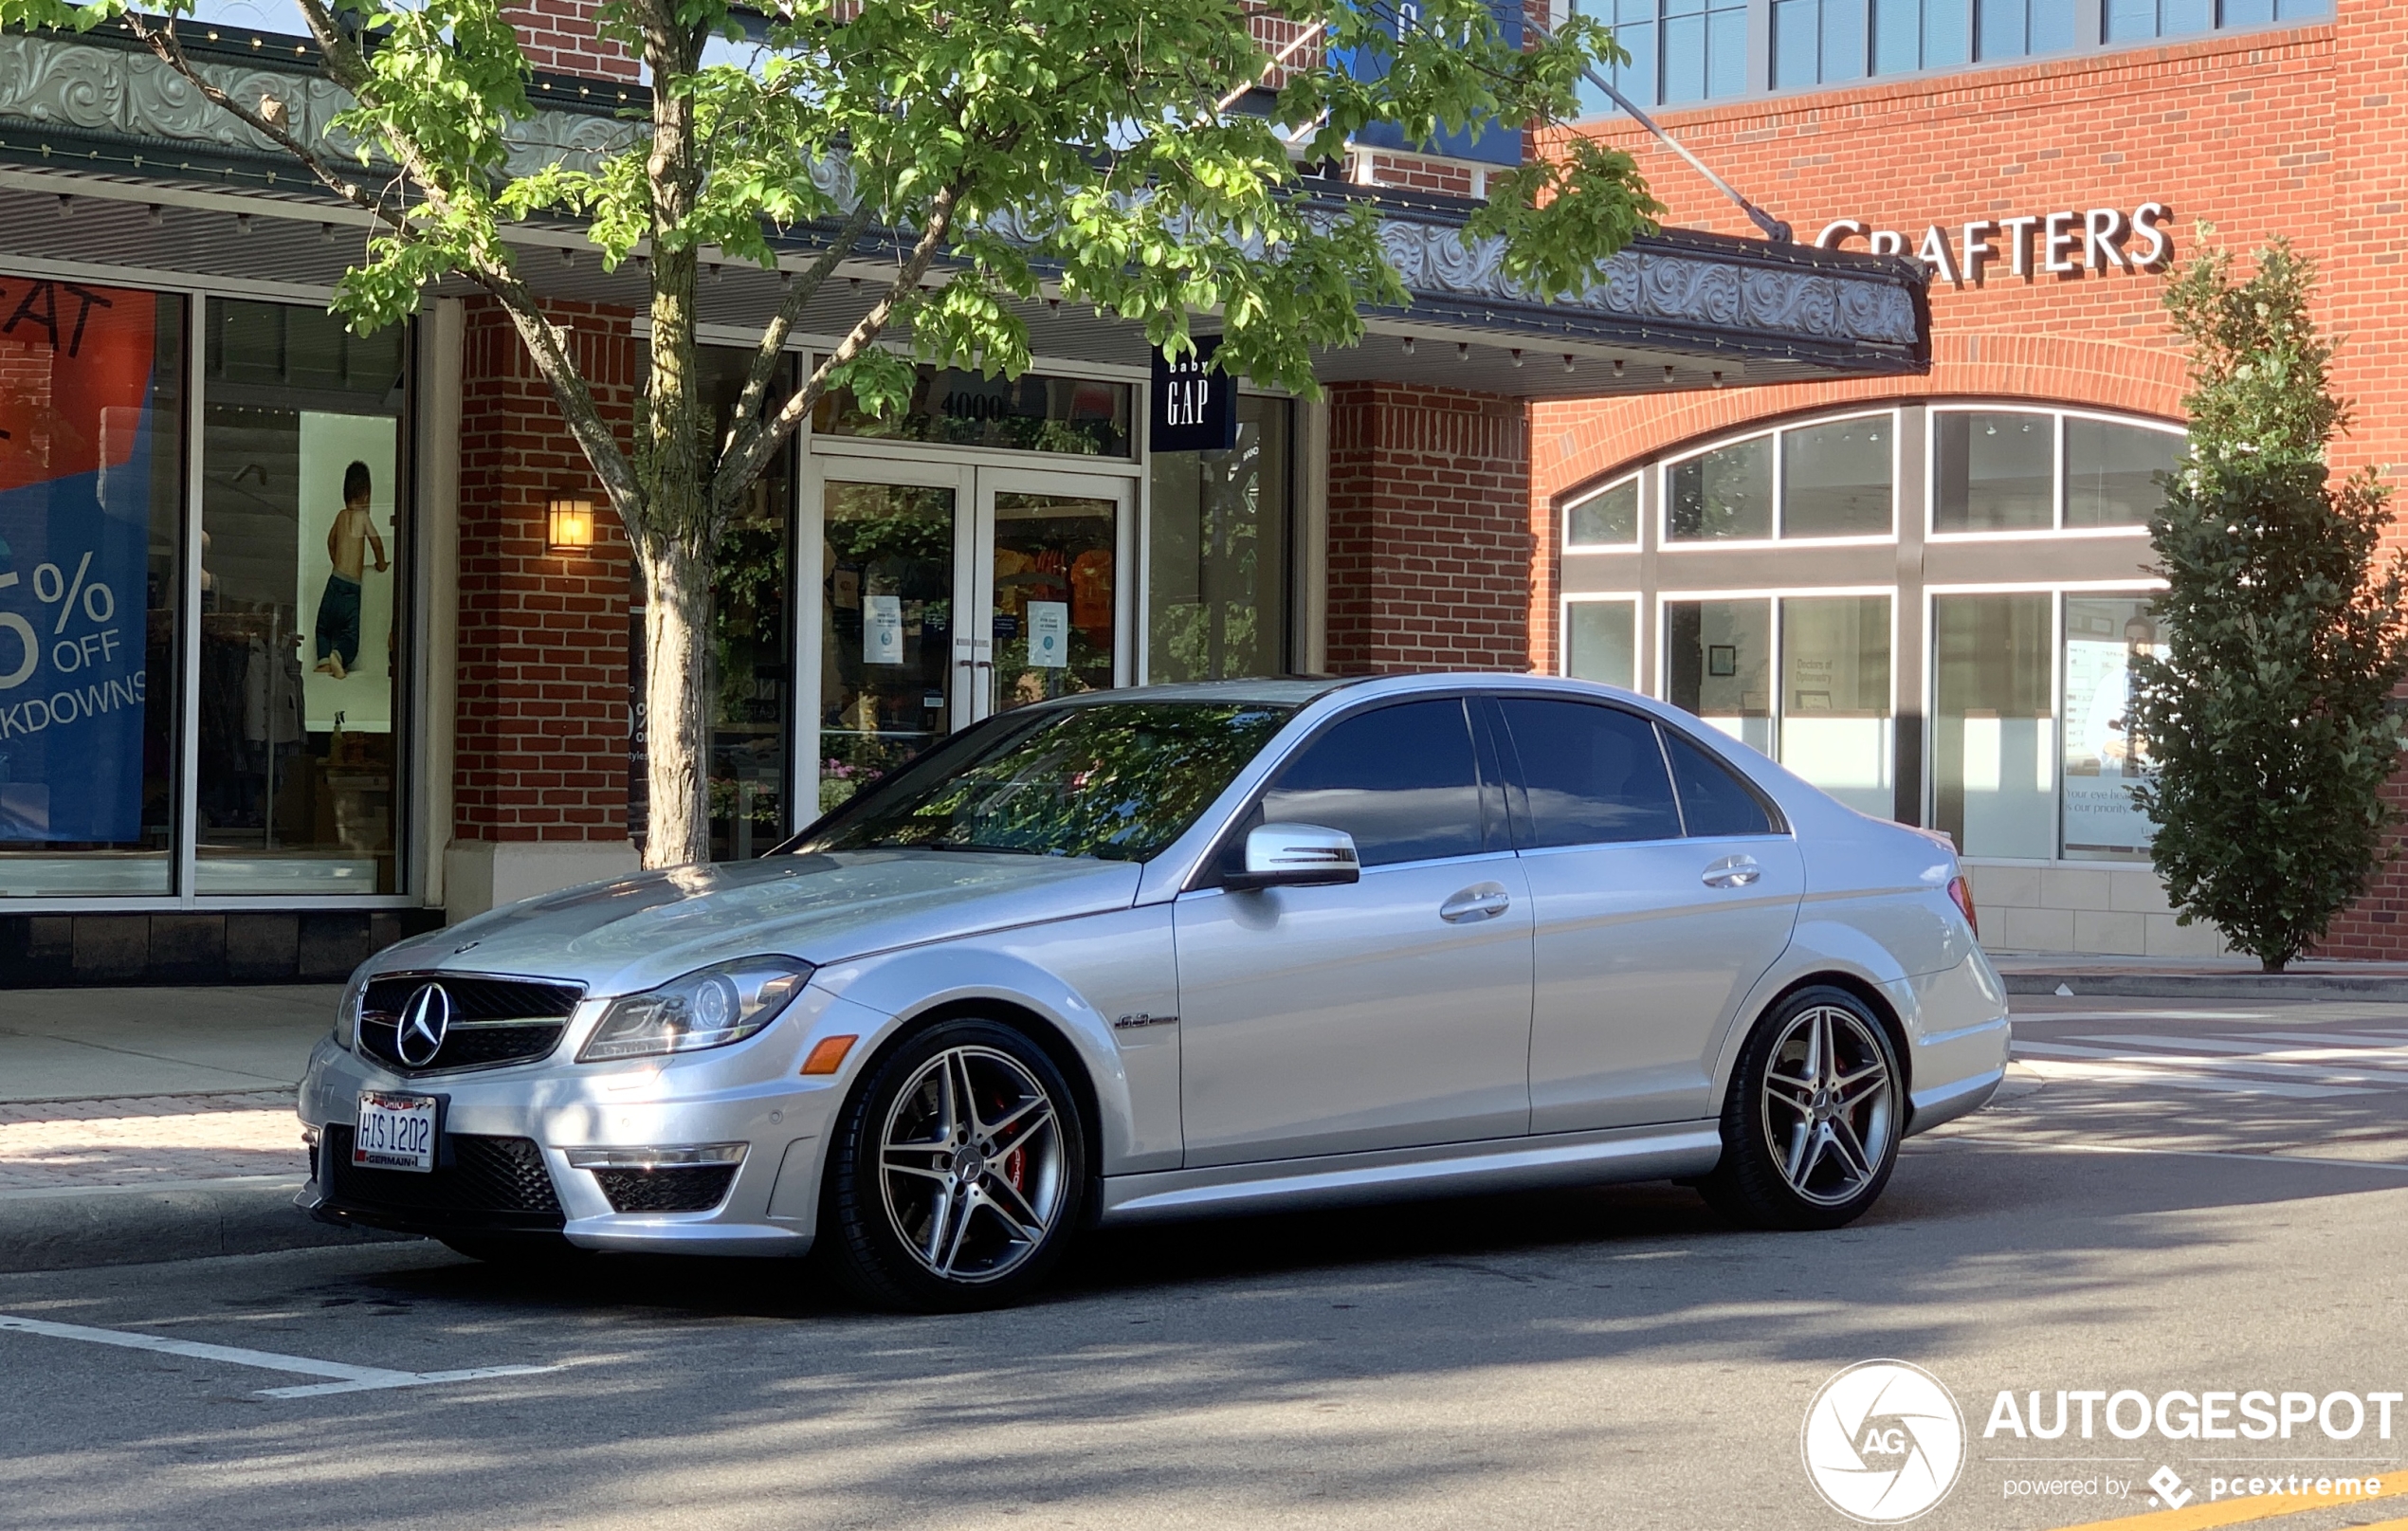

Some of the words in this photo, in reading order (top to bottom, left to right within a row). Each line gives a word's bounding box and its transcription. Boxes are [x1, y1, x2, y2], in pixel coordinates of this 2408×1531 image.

[0, 282, 113, 358] AT
[1169, 361, 1209, 374] baby
[940, 391, 1003, 424] 4000
[1167, 379, 1209, 426] GAP
[52, 629, 120, 673] OFF
[0, 670, 146, 739] KDOWNS
[2066, 788, 2088, 799] Your
[2090, 791, 2107, 801] eye
[2074, 804, 2091, 812] our
[361, 1112, 385, 1149] HIS
[390, 1115, 429, 1154] 1202
